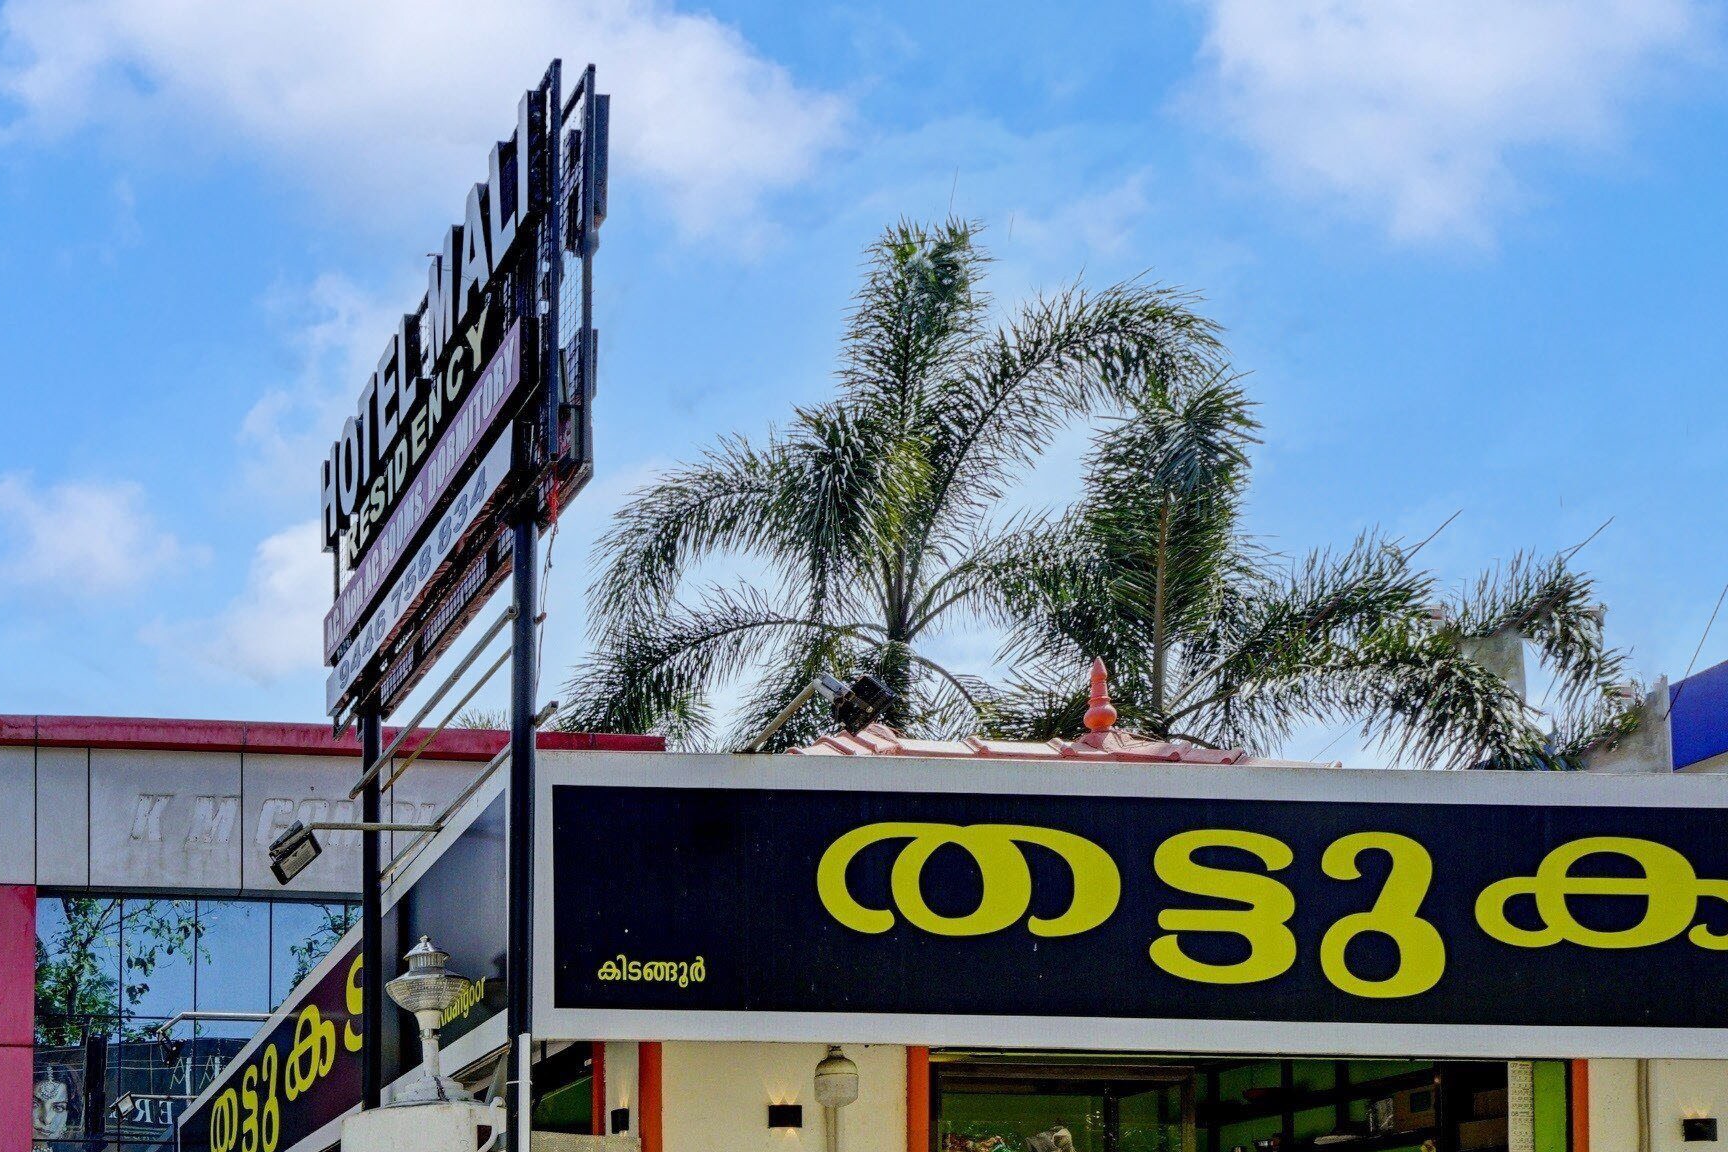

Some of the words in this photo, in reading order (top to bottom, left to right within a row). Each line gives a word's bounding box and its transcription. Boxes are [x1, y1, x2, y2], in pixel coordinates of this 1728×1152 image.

[321, 314, 417, 552] HOTEL
[428, 89, 530, 374] MALI
[427, 335, 515, 504] DORMITORY
[347, 303, 488, 568] RESIDENCY
[339, 609, 386, 690] 9446
[391, 545, 432, 619] 758
